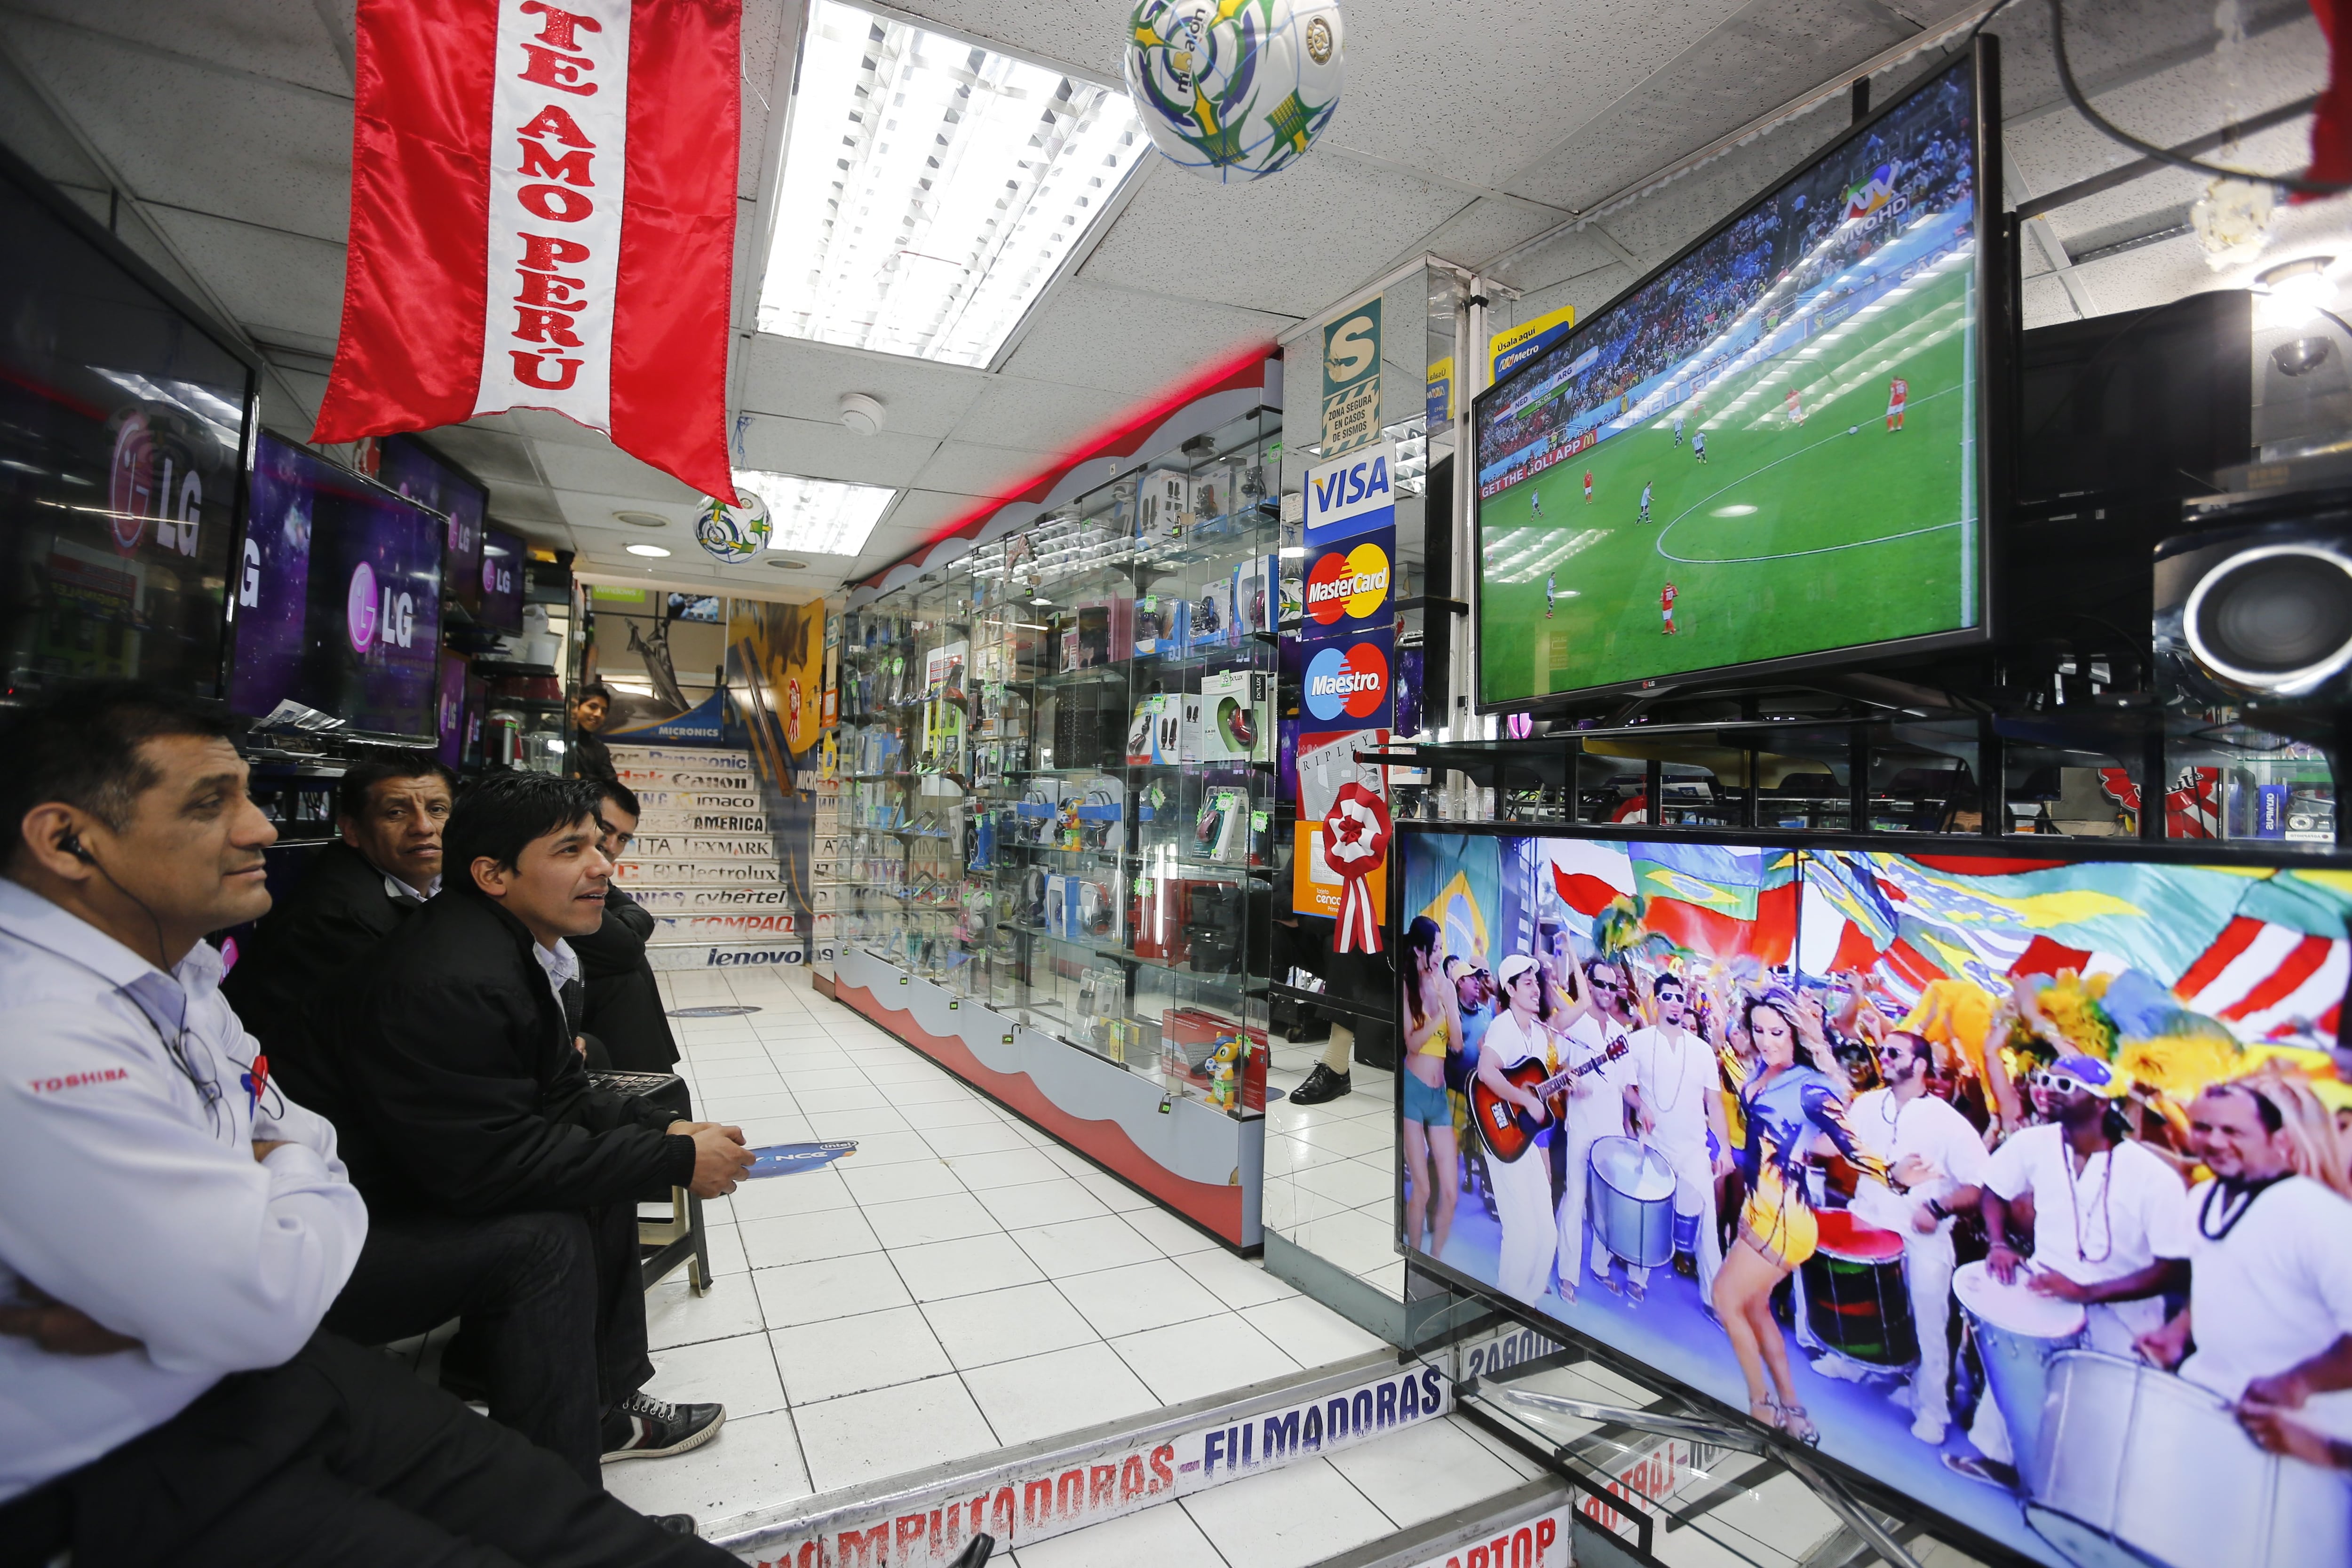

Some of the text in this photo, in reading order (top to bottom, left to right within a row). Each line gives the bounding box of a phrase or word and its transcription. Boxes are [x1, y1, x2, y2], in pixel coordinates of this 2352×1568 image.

[518, 0, 602, 96] TE
[516, 104, 596, 223] AMO
[508, 231, 591, 390] PERÚ
[1330, 315, 1375, 383] S
[1497, 326, 1536, 352] Úsala aquí
[1513, 345, 1539, 364] Metro
[1515, 396, 1528, 409] NED
[1557, 366, 1573, 382] ARG
[1534, 393, 1552, 408] 75:02
[1328, 394, 1372, 421] ZONA SEGURA
[1335, 409, 1365, 430] EN CASOS
[1333, 421, 1367, 442] DE SISMOS
[1482, 479, 1502, 498] GET
[1503, 468, 1524, 488] THE
[1529, 454, 1553, 474] OL!
[1555, 439, 1581, 462] APP
[1311, 455, 1390, 513] VISA
[157, 457, 202, 558] LG
[458, 524, 470, 553] LG
[496, 568, 511, 594] LG
[1308, 566, 1388, 604] MasterCard
[381, 586, 413, 649] LG
[1311, 671, 1379, 697] Maestro
[659, 726, 719, 737] MICRONICS
[672, 772, 747, 790] Canon
[696, 796, 755, 808] imaco
[693, 816, 763, 832] AMERICA
[695, 890, 787, 905] cybertel
[706, 948, 802, 966] lenovo
[29, 1067, 128, 1094] TOSHIBA
